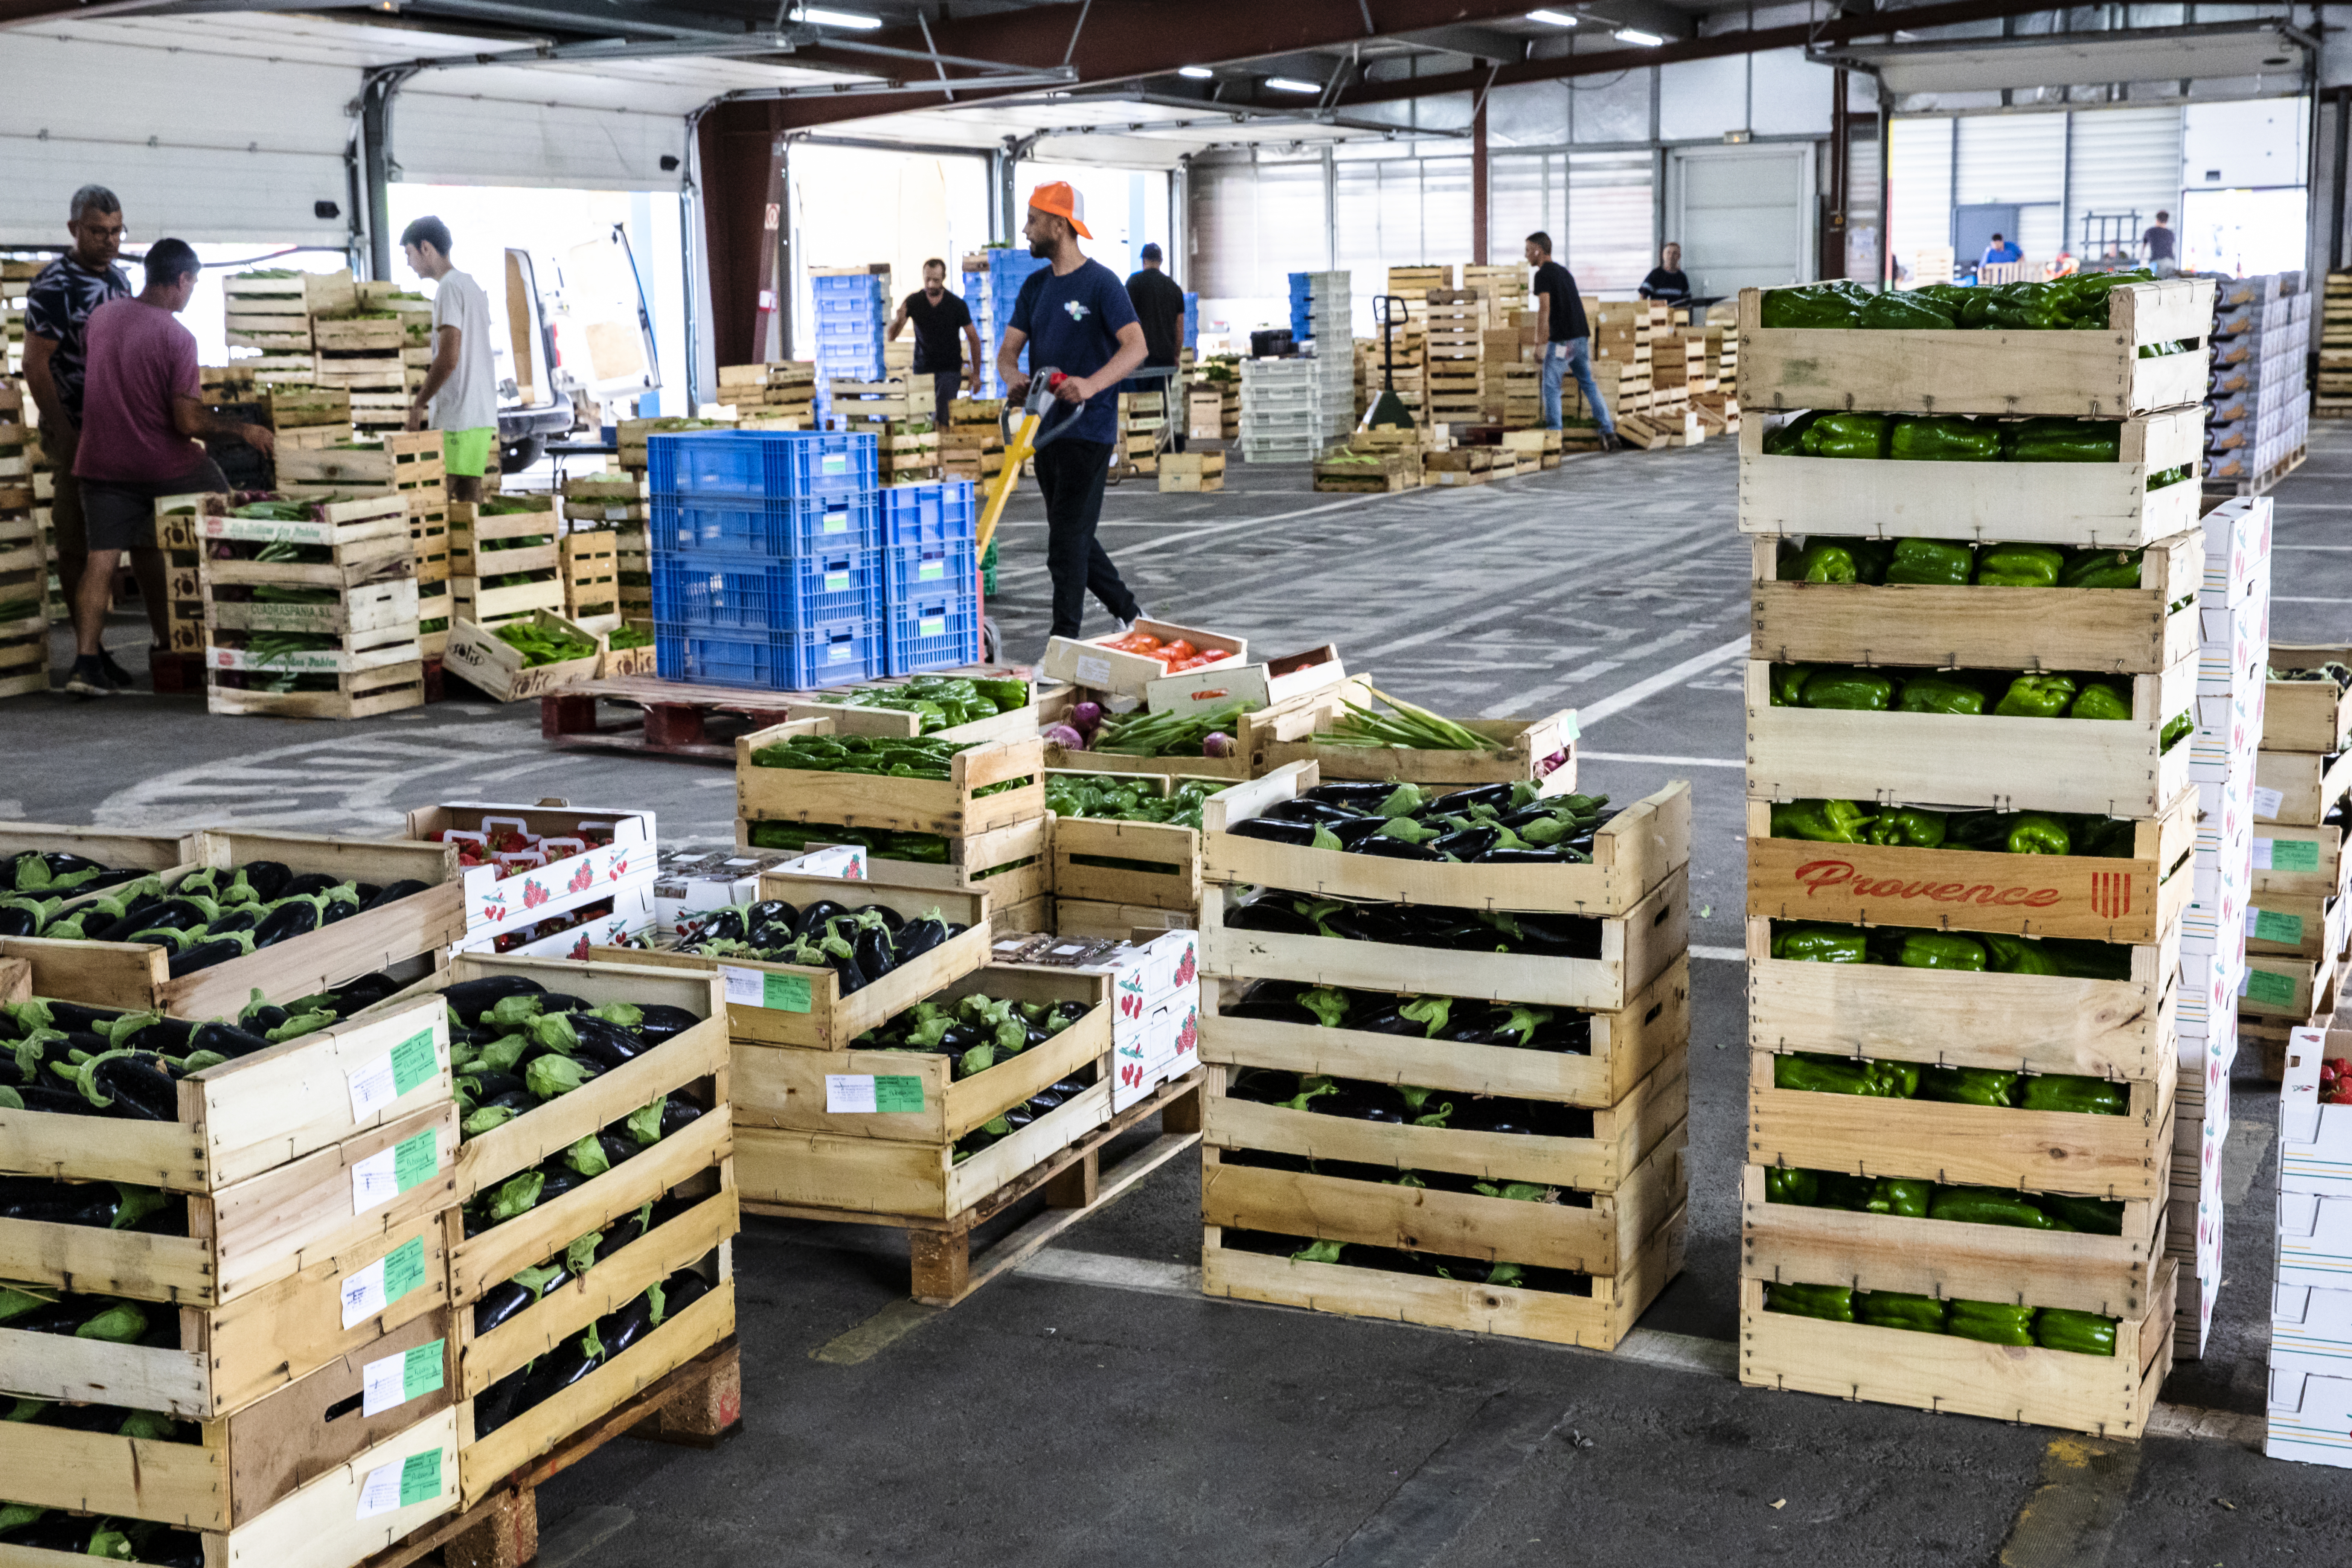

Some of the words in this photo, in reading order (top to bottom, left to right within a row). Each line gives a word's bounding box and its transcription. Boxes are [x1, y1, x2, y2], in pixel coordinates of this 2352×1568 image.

[164, 517, 199, 547] soli
[174, 569, 200, 597] sol
[1795, 860, 2062, 907] Provence
